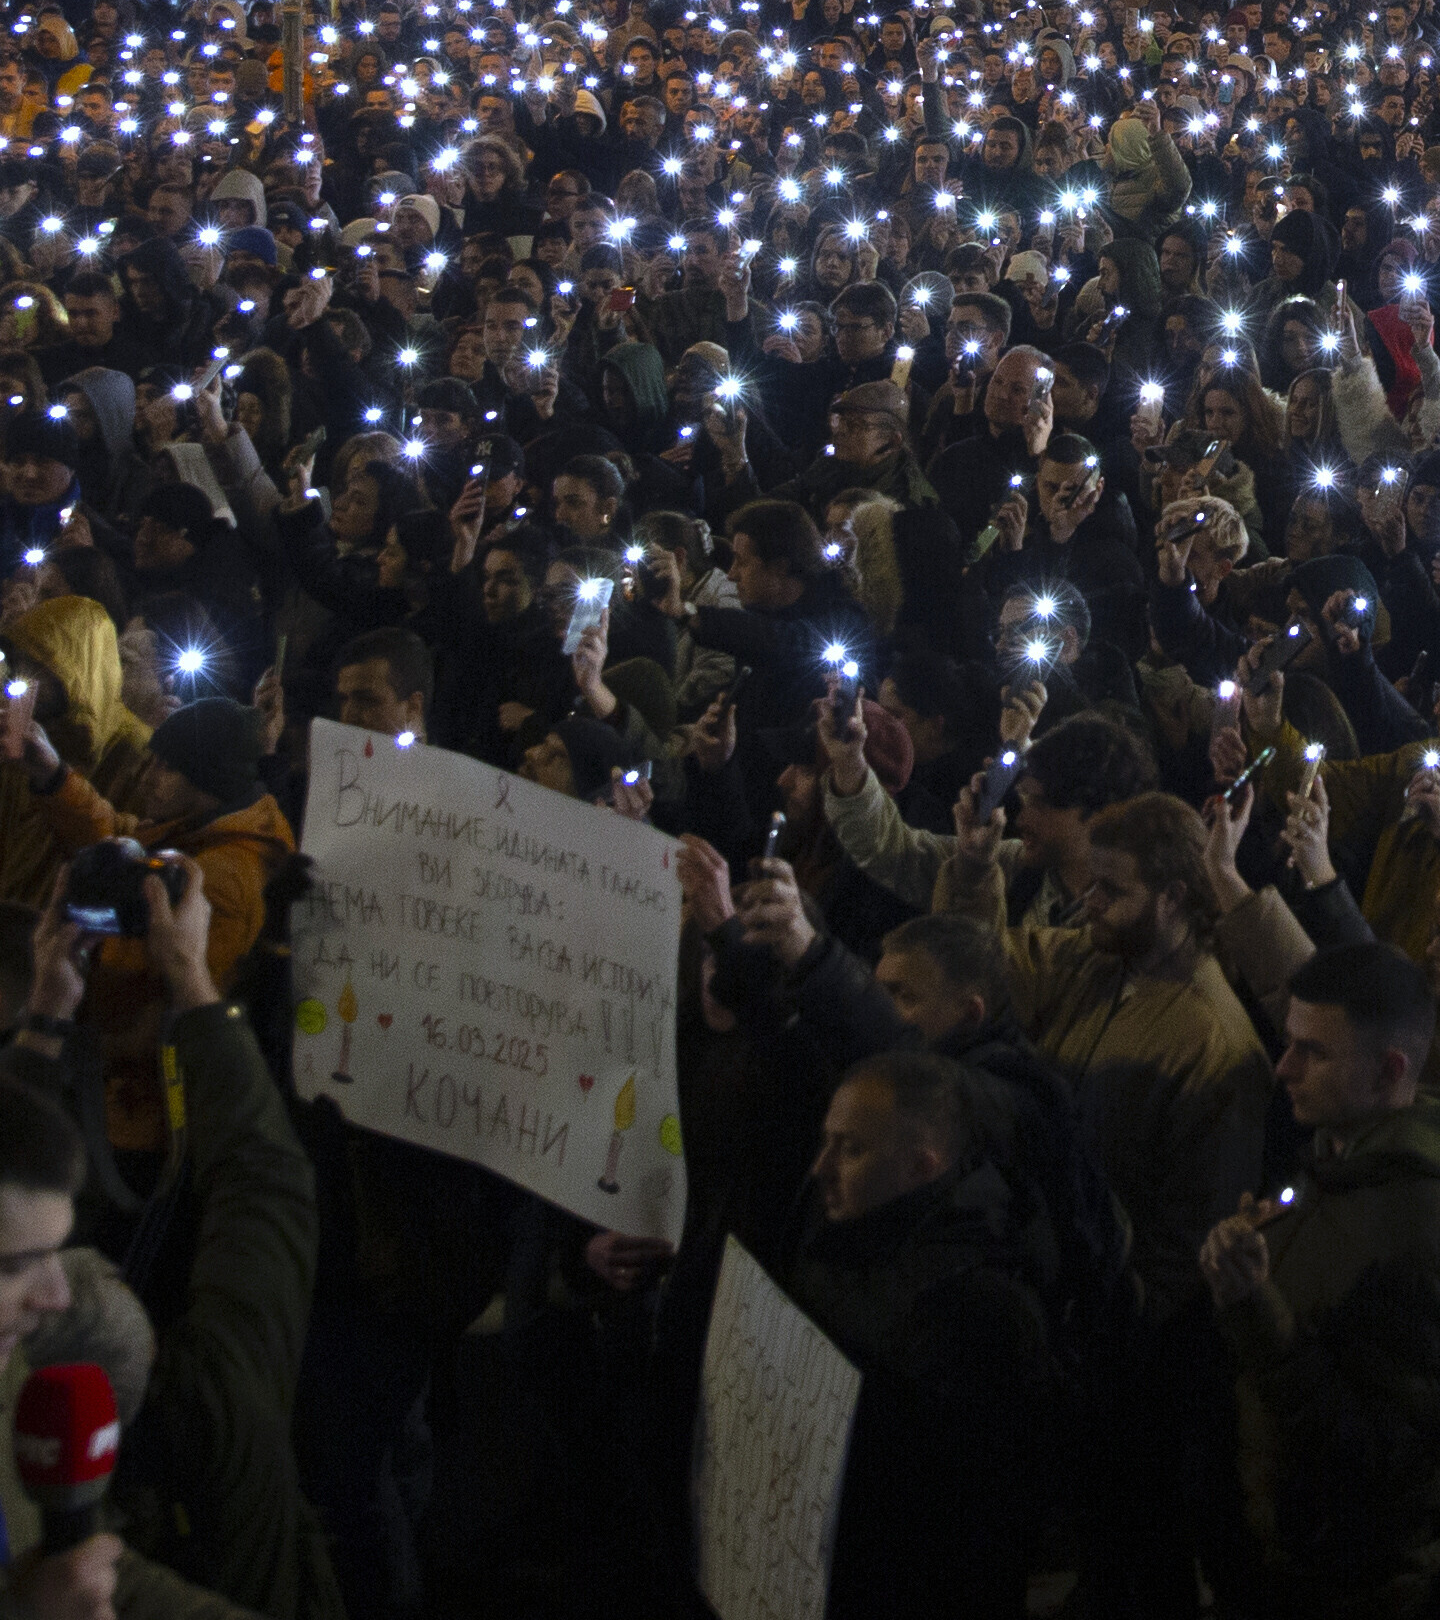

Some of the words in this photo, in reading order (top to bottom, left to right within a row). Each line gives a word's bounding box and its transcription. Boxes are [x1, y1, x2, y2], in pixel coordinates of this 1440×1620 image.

[306, 882, 386, 927] НЕМА
[422, 1013, 549, 1076] 16.03.2025
[403, 1061, 571, 1178] КОЧАНИ
